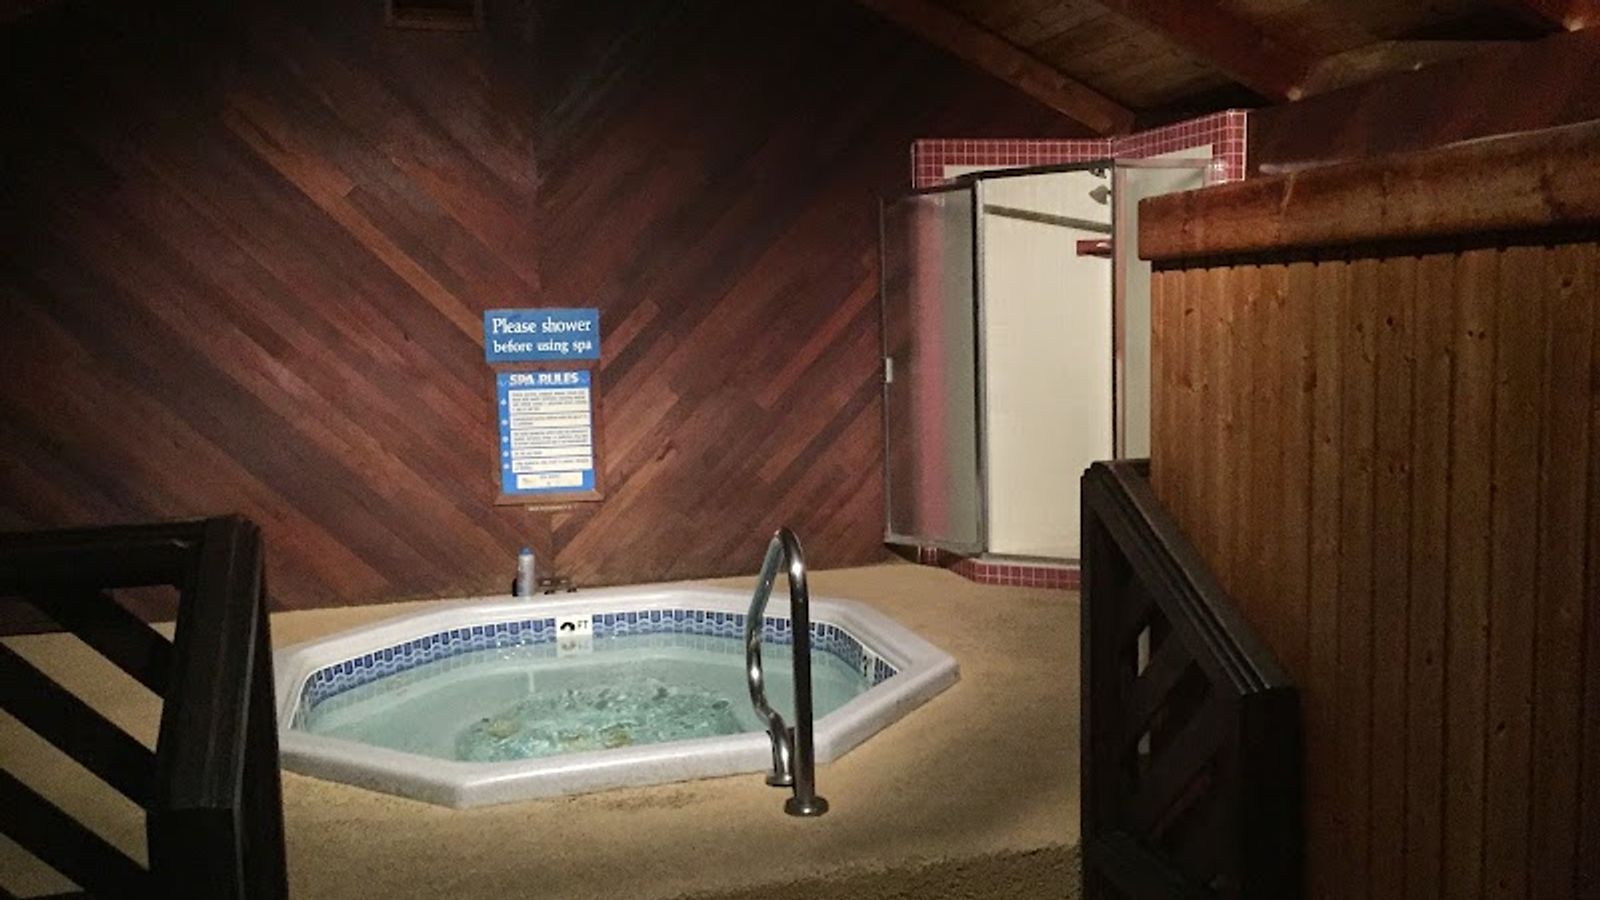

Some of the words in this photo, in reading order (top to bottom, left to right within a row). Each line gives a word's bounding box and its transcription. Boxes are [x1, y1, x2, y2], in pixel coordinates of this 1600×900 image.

[493, 318, 536, 334] Please
[542, 317, 591, 332] shower
[494, 339, 533, 353] before
[538, 339, 569, 354] using
[573, 341, 592, 353] spa
[510, 373, 534, 385] SPA
[539, 372, 578, 385] RULES
